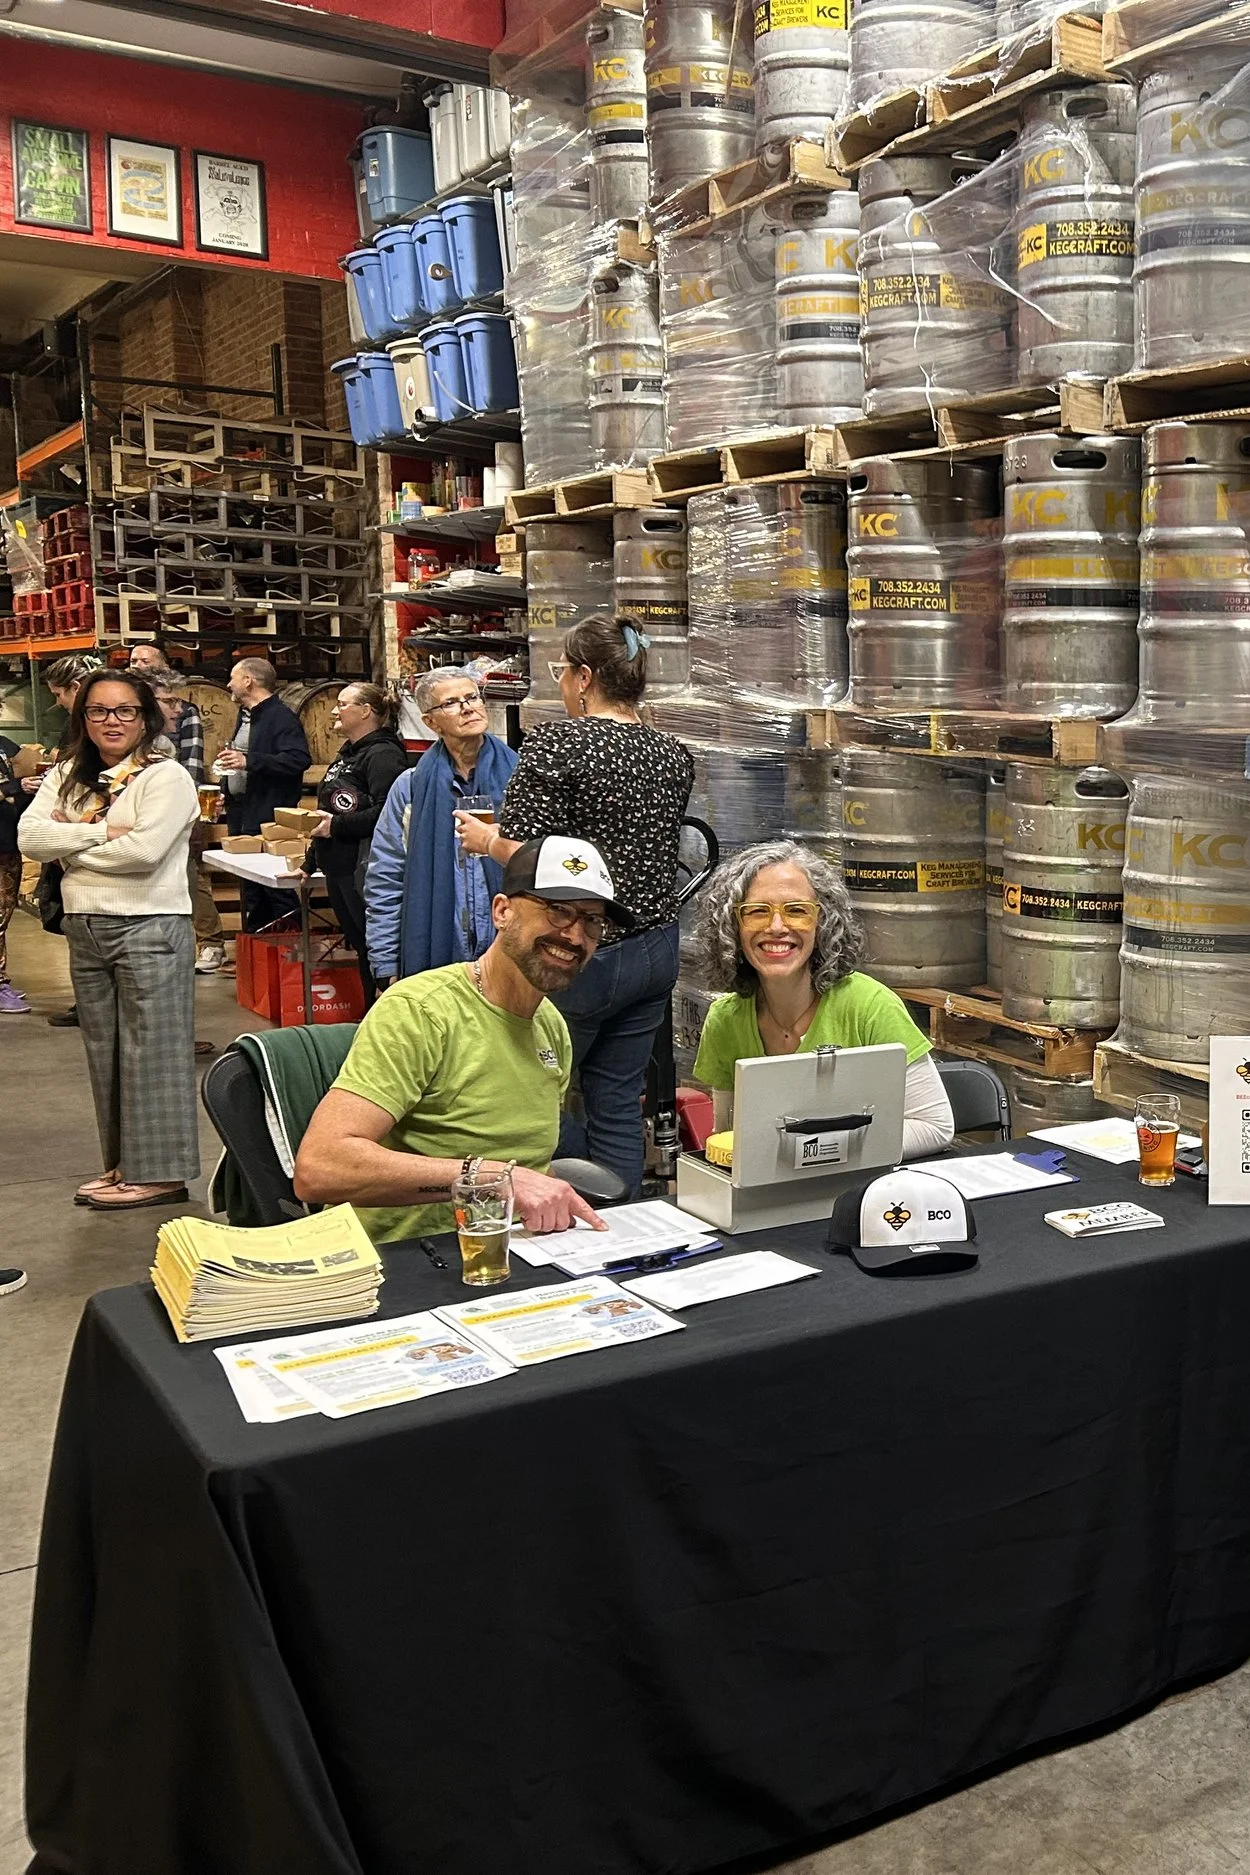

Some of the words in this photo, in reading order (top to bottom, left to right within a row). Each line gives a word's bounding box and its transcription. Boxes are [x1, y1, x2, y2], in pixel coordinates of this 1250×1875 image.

[817, 6, 839, 19] KC
[592, 57, 628, 83] KC
[1023, 148, 1066, 190] KC
[1056, 220, 1130, 237] 708.352.2434
[1026, 235, 1044, 255] KC
[1049, 236, 1135, 256] KEGCRAFT.COM
[824, 238, 858, 270] K
[604, 307, 635, 330] KC
[1012, 488, 1068, 527] KC
[859, 512, 899, 537] KC
[641, 548, 686, 571] KC
[878, 580, 941, 594] 708.352.2434
[852, 589, 867, 602] KC
[872, 596, 947, 610] KEGCRAFT.COM
[531, 608, 553, 626] KC
[650, 605, 687, 616] KEGCRAFT
[1173, 833, 1248, 868] KC
[921, 863, 936, 872] KEG
[938, 861, 981, 871] MANAGEMENT
[859, 870, 915, 880] KEGCRAFT.COM
[930, 871, 963, 880] SERVICES
[926, 880, 950, 888] CRAFT
[1022, 894, 1070, 909] 708.352.2434
[1077, 899, 1124, 911] KEGCRAFT
[1161, 935, 1216, 946] 708.352.2434
[297, 1002, 351, 1013] DORDASH
[803, 1143, 819, 1159] BCO
[928, 1209, 951, 1221] BCO
[1089, 1203, 1132, 1214] BCO
